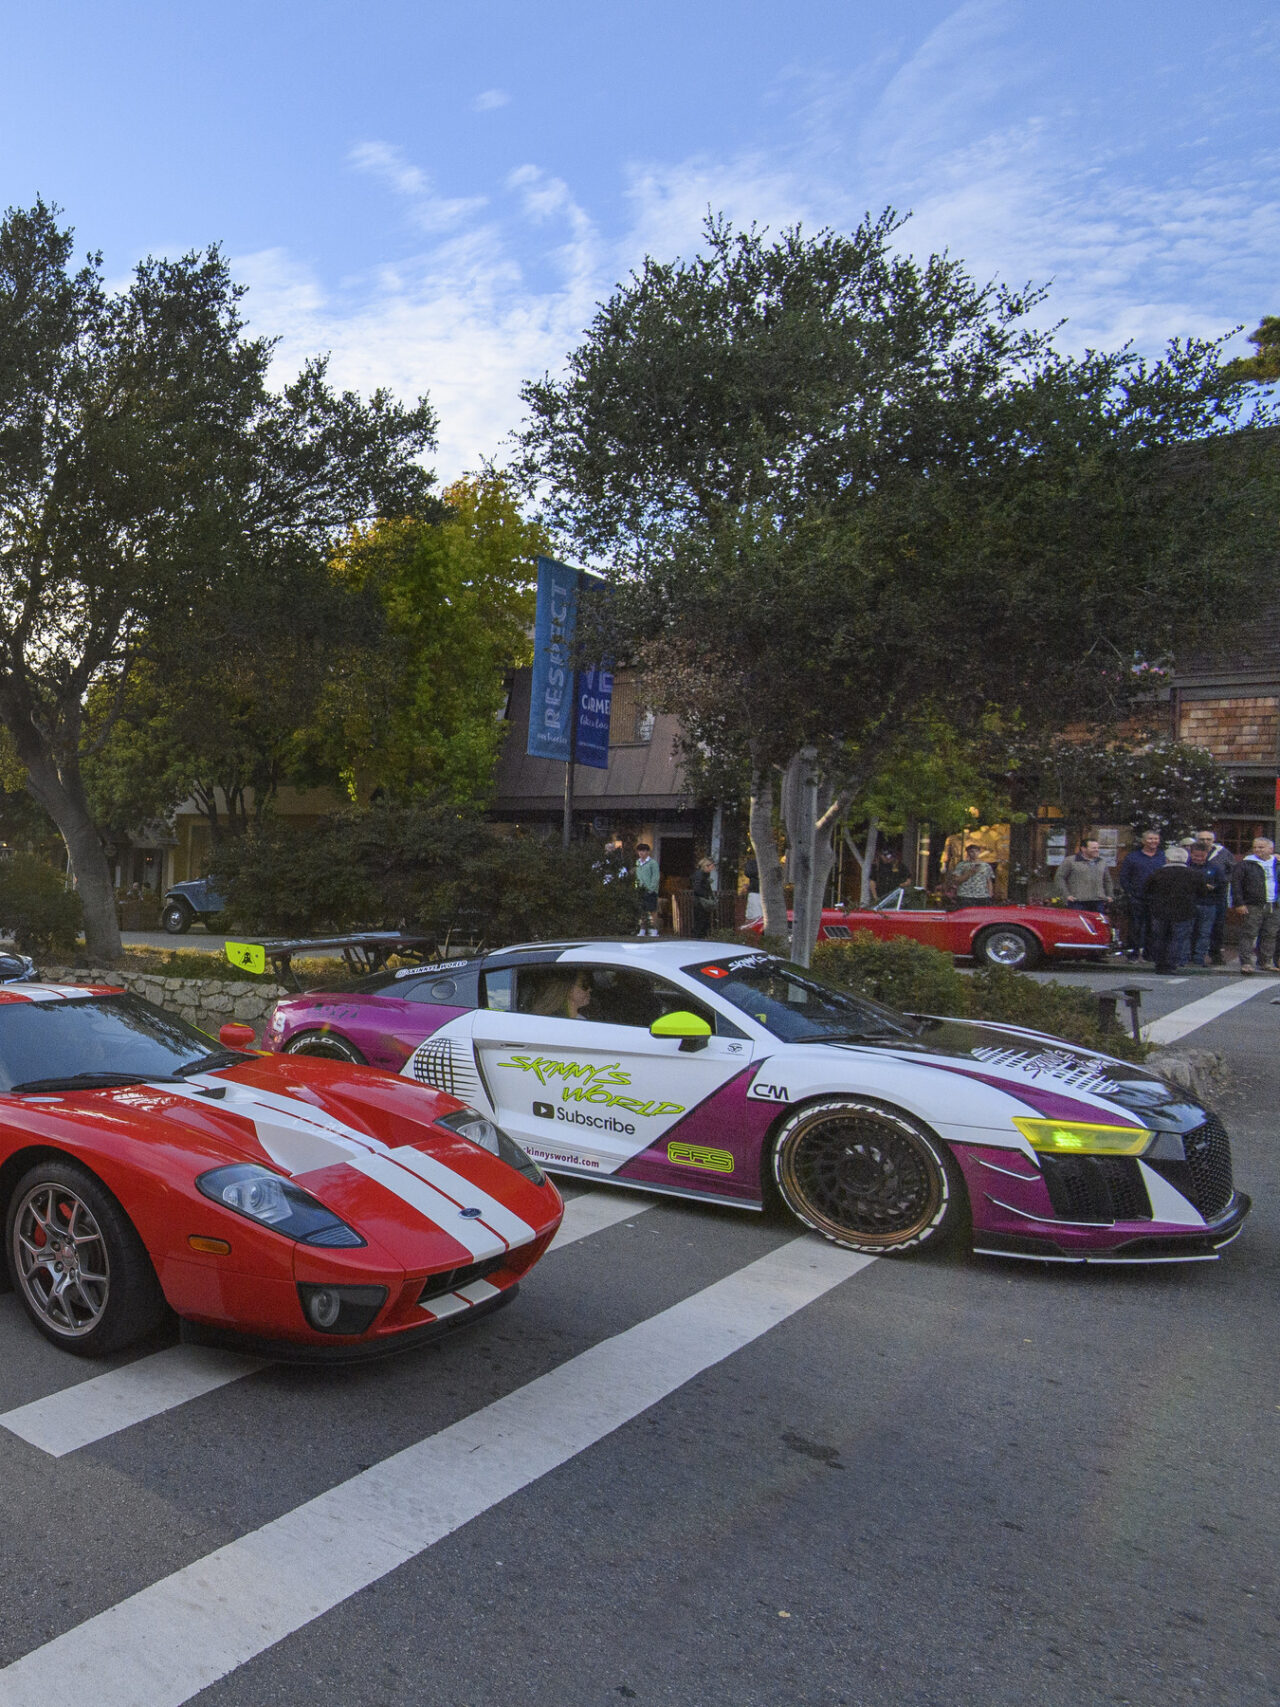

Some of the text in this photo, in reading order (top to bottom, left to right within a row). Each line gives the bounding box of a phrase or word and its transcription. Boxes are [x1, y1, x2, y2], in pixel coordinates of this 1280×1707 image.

[544, 579, 567, 728] RESPECT
[288, 1037, 334, 1054] ORLD
[497, 1056, 631, 1086] SKINNY'S
[562, 1084, 686, 1117] WORLD
[753, 1083, 790, 1101] CM
[557, 1107, 636, 1135] Subscribe
[523, 1146, 600, 1168] kinnysworld.com
[673, 1150, 734, 1167] PFS
